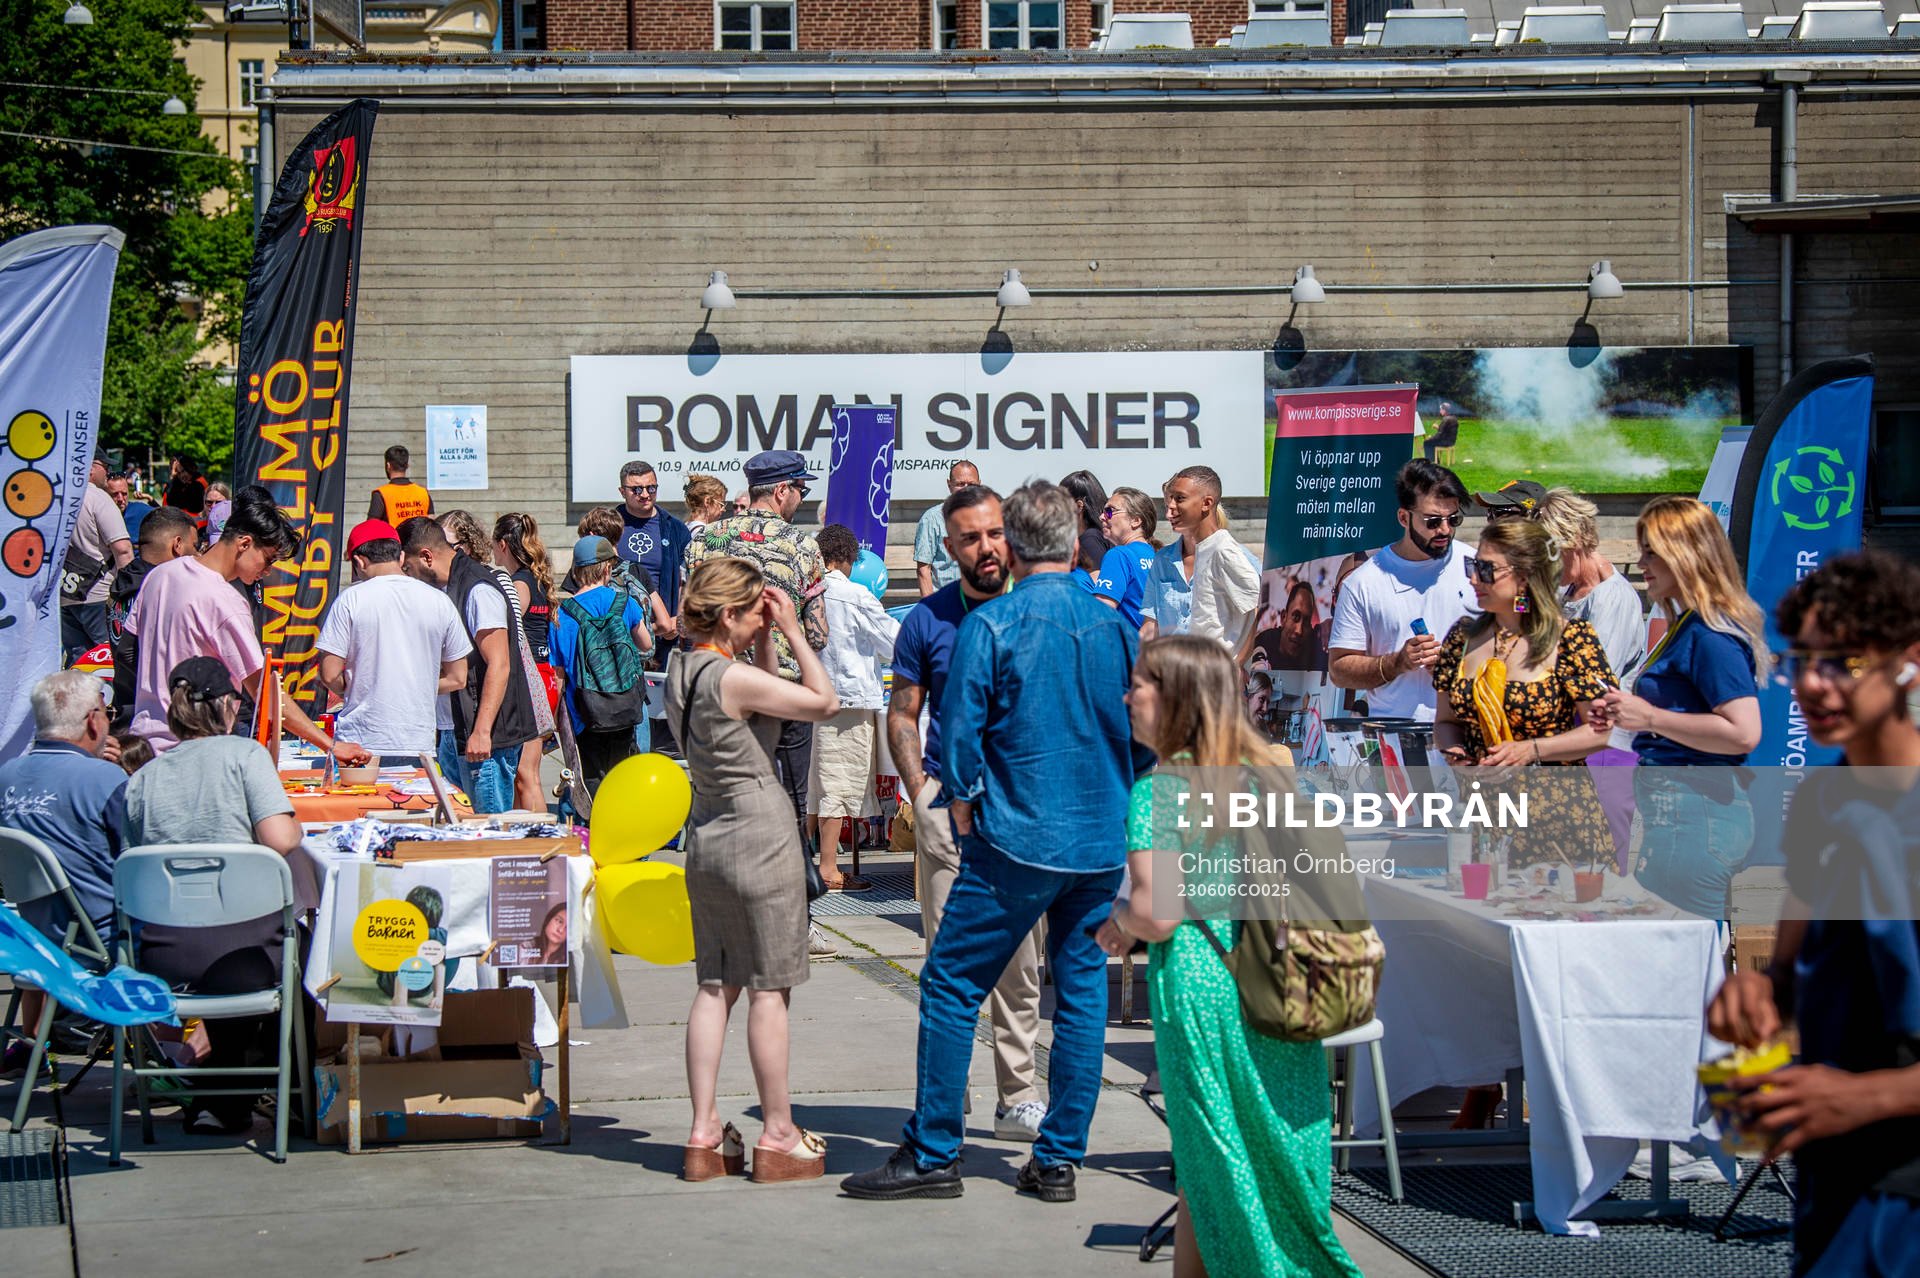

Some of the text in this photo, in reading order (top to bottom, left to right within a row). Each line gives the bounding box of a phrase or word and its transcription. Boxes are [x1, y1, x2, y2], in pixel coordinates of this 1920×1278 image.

[311, 319, 344, 471] CLUB
[1288, 404, 1401, 421] www.kompissverige.se
[926, 392, 1201, 451] SIGNER
[658, 461, 682, 472] 10.9
[689, 459, 741, 472] MALMÖ
[1300, 450, 1381, 468] Vi öppnar upp
[64, 410, 89, 539] UTAN GRÄNSER
[1295, 475, 1382, 492] Sverige genom
[1296, 498, 1376, 514] möten mellan
[1302, 523, 1364, 538] människor
[516, 861, 542, 869] magen
[367, 916, 416, 926] TRYGGA
